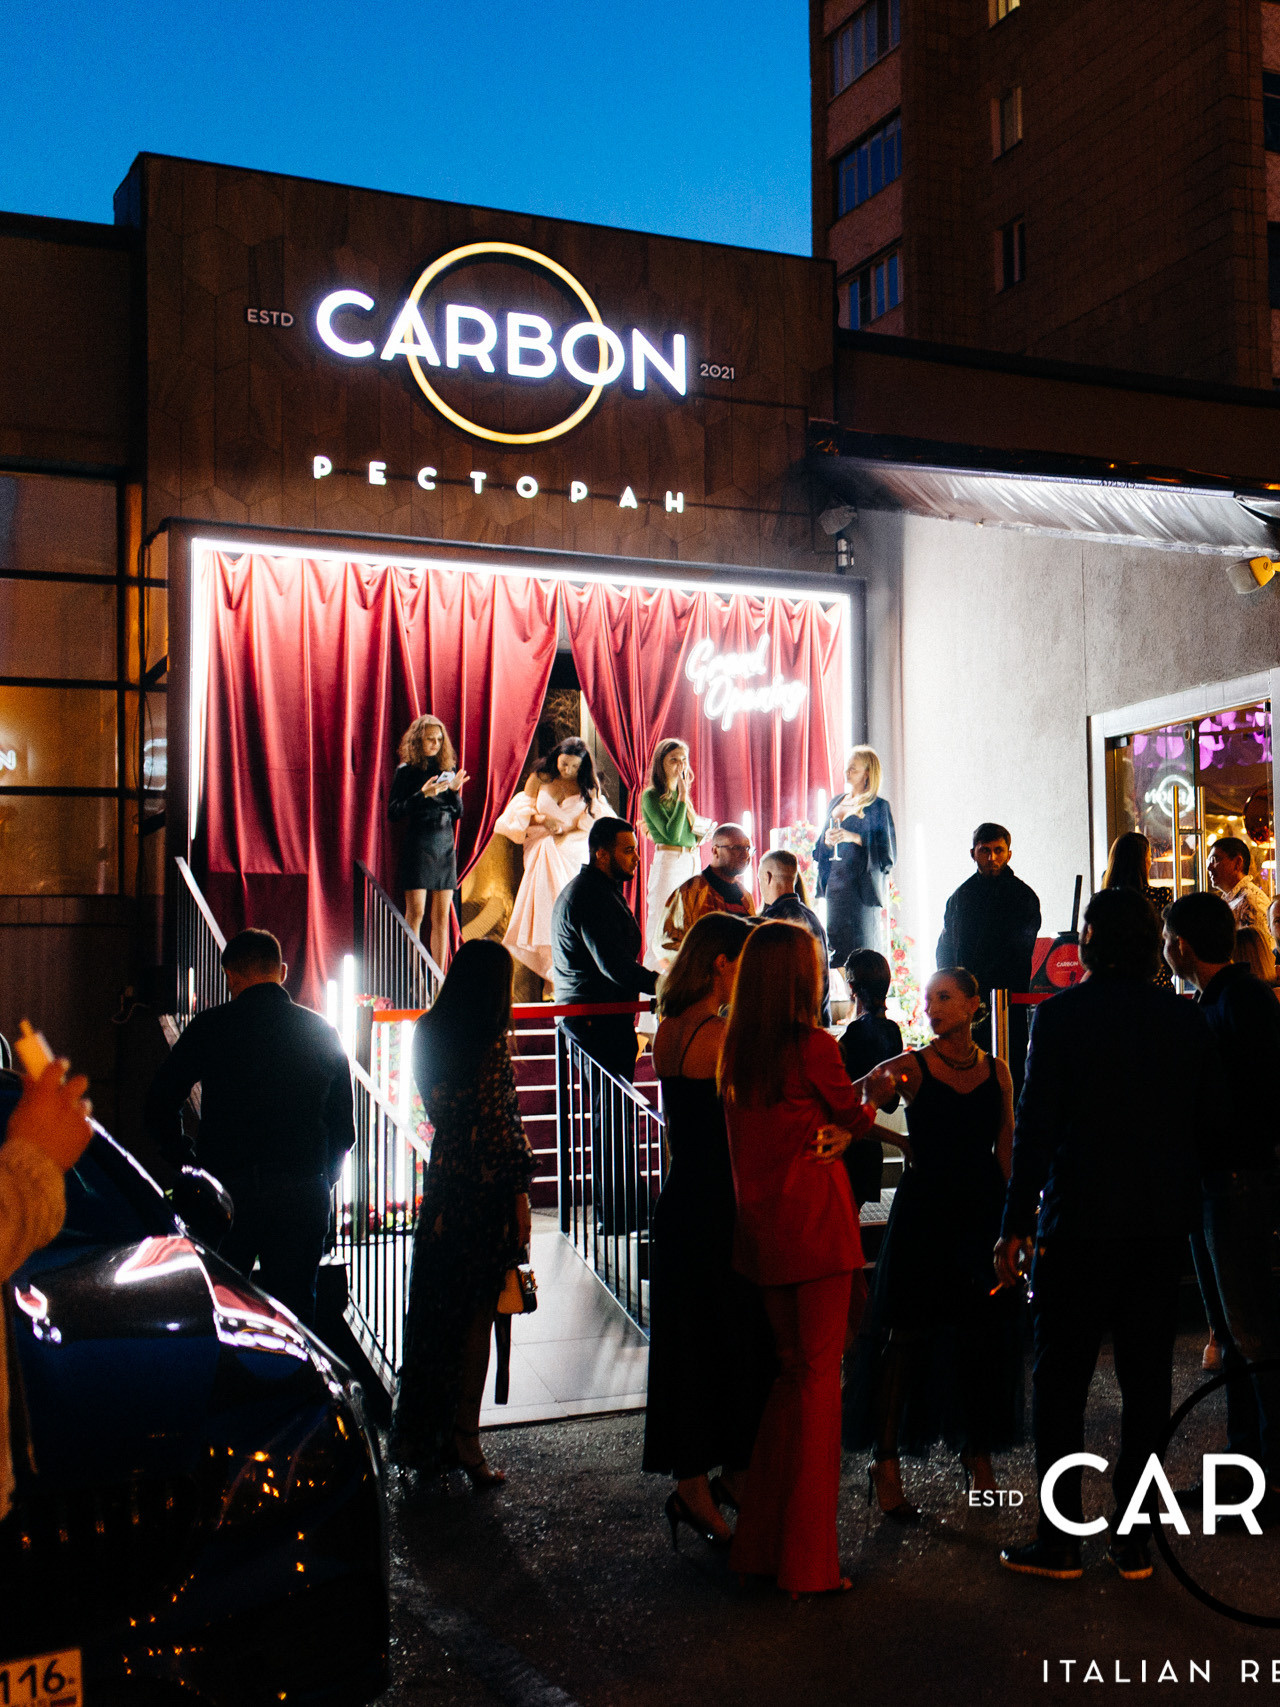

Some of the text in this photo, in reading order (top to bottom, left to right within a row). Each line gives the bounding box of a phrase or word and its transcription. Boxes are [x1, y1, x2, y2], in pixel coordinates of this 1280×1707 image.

[247, 289, 735, 397] ESTD CARBON 2021
[314, 455, 684, 513] РЕСТОРАН
[0, 1659, 66, 1704] 116
